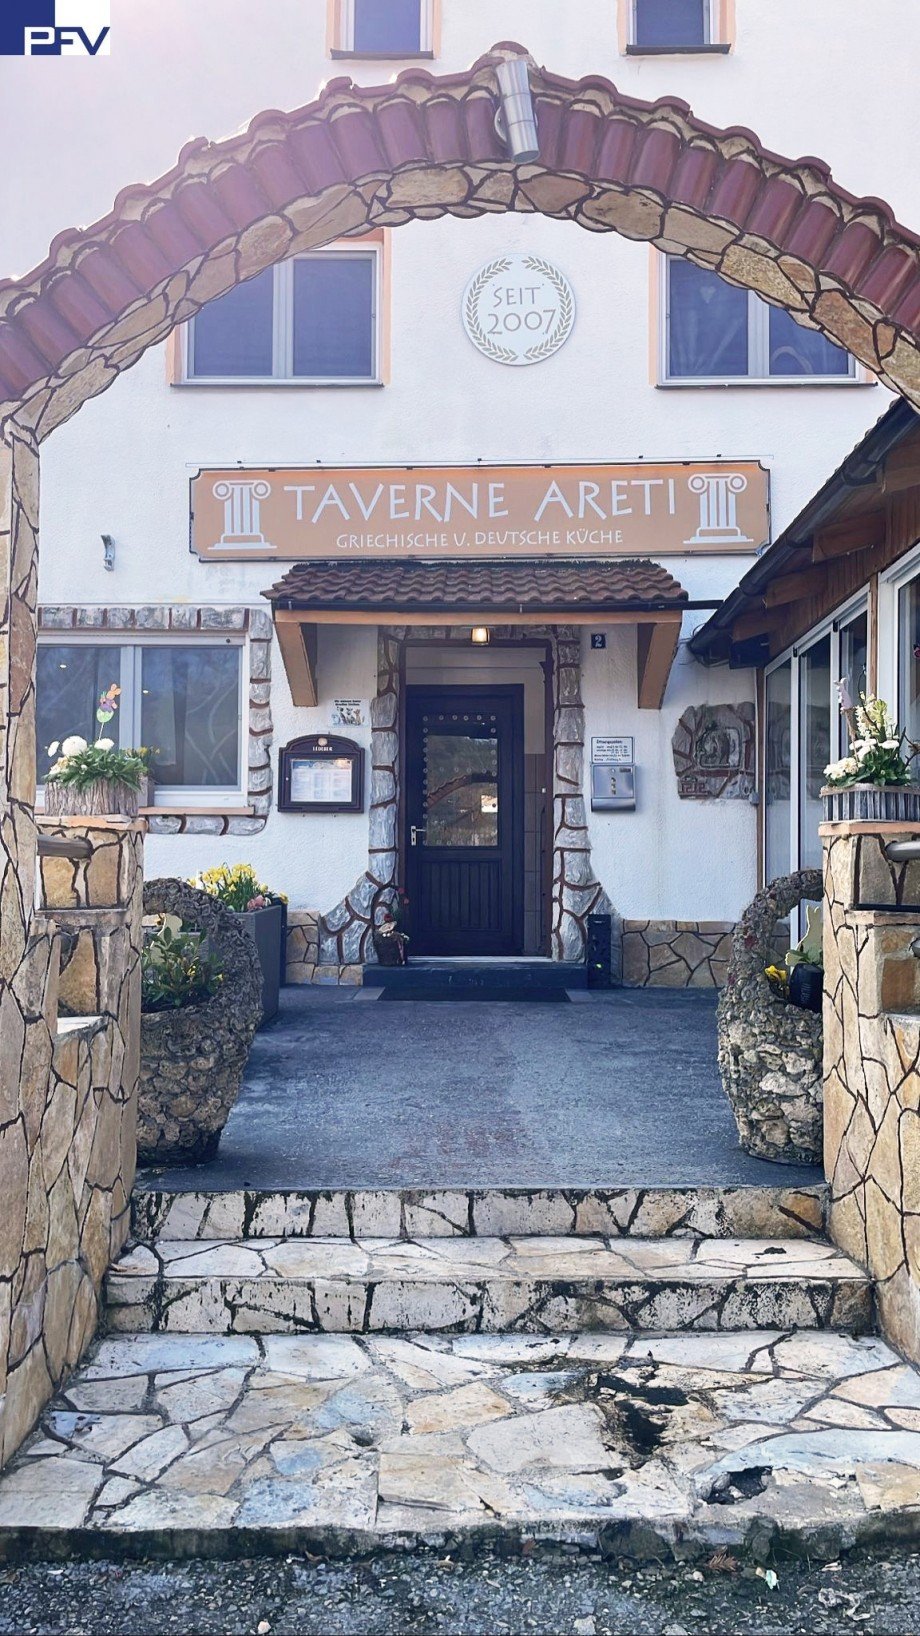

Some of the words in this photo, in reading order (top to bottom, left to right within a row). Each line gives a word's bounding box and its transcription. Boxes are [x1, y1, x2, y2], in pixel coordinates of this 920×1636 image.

[493, 286, 541, 308] SEIT
[487, 308, 557, 335] 2007
[283, 482, 509, 524] TAVERNE
[533, 478, 675, 522] ARETI
[336, 532, 449, 549] GRIECHISCHE
[453, 532, 471, 547] U.
[475, 530, 560, 546] DEUTSCHE
[566, 527, 624, 544] KÜCHE
[594, 635, 603, 648] 2
